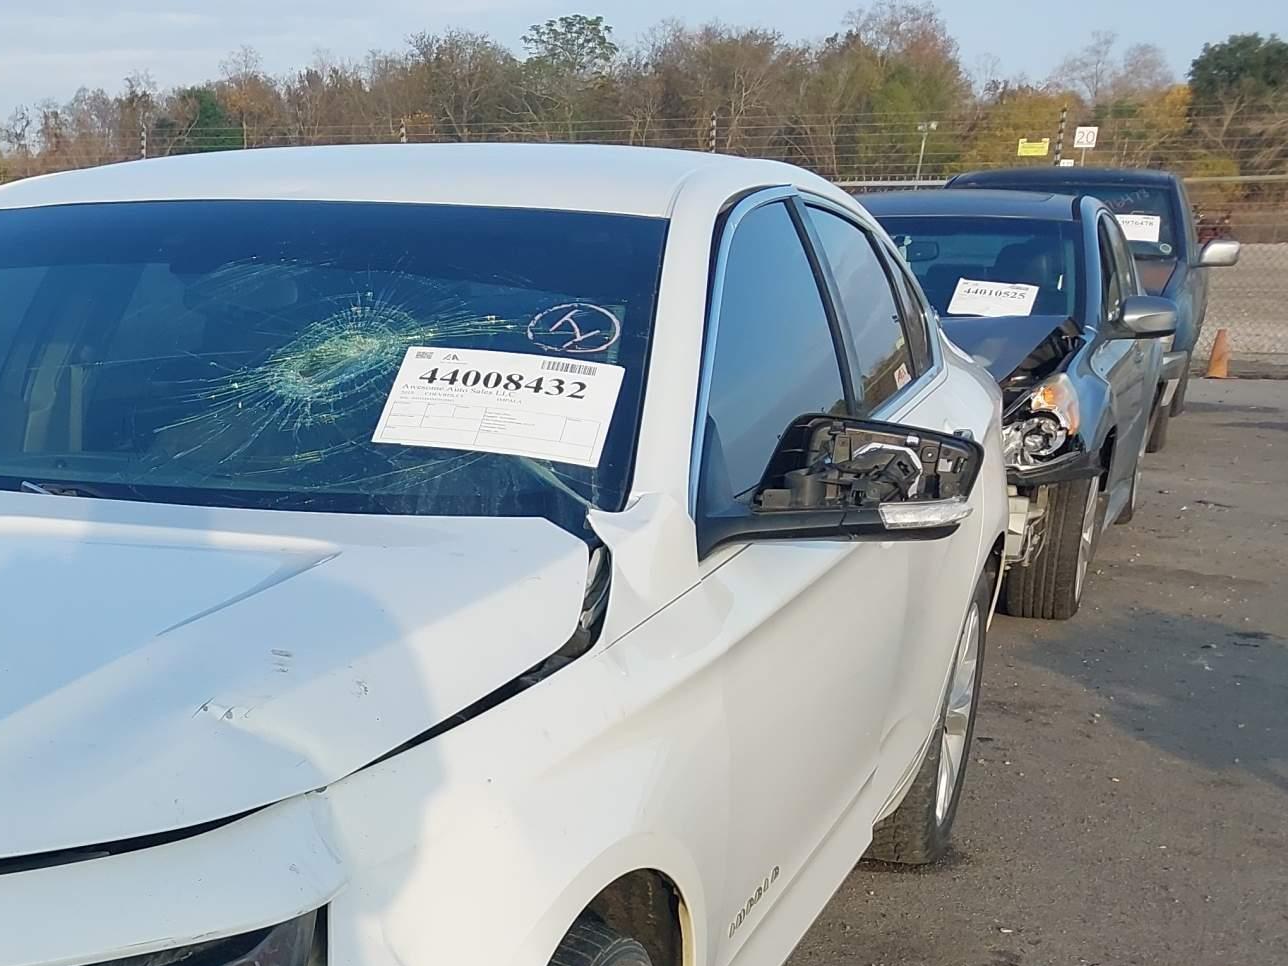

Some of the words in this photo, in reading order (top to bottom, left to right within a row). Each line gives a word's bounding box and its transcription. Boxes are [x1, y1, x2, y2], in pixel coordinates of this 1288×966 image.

[1077, 130, 1095, 143] 20
[964, 287, 1026, 300] 44010525
[419, 367, 587, 400] 44008432
[470, 388, 493, 396] Sales
